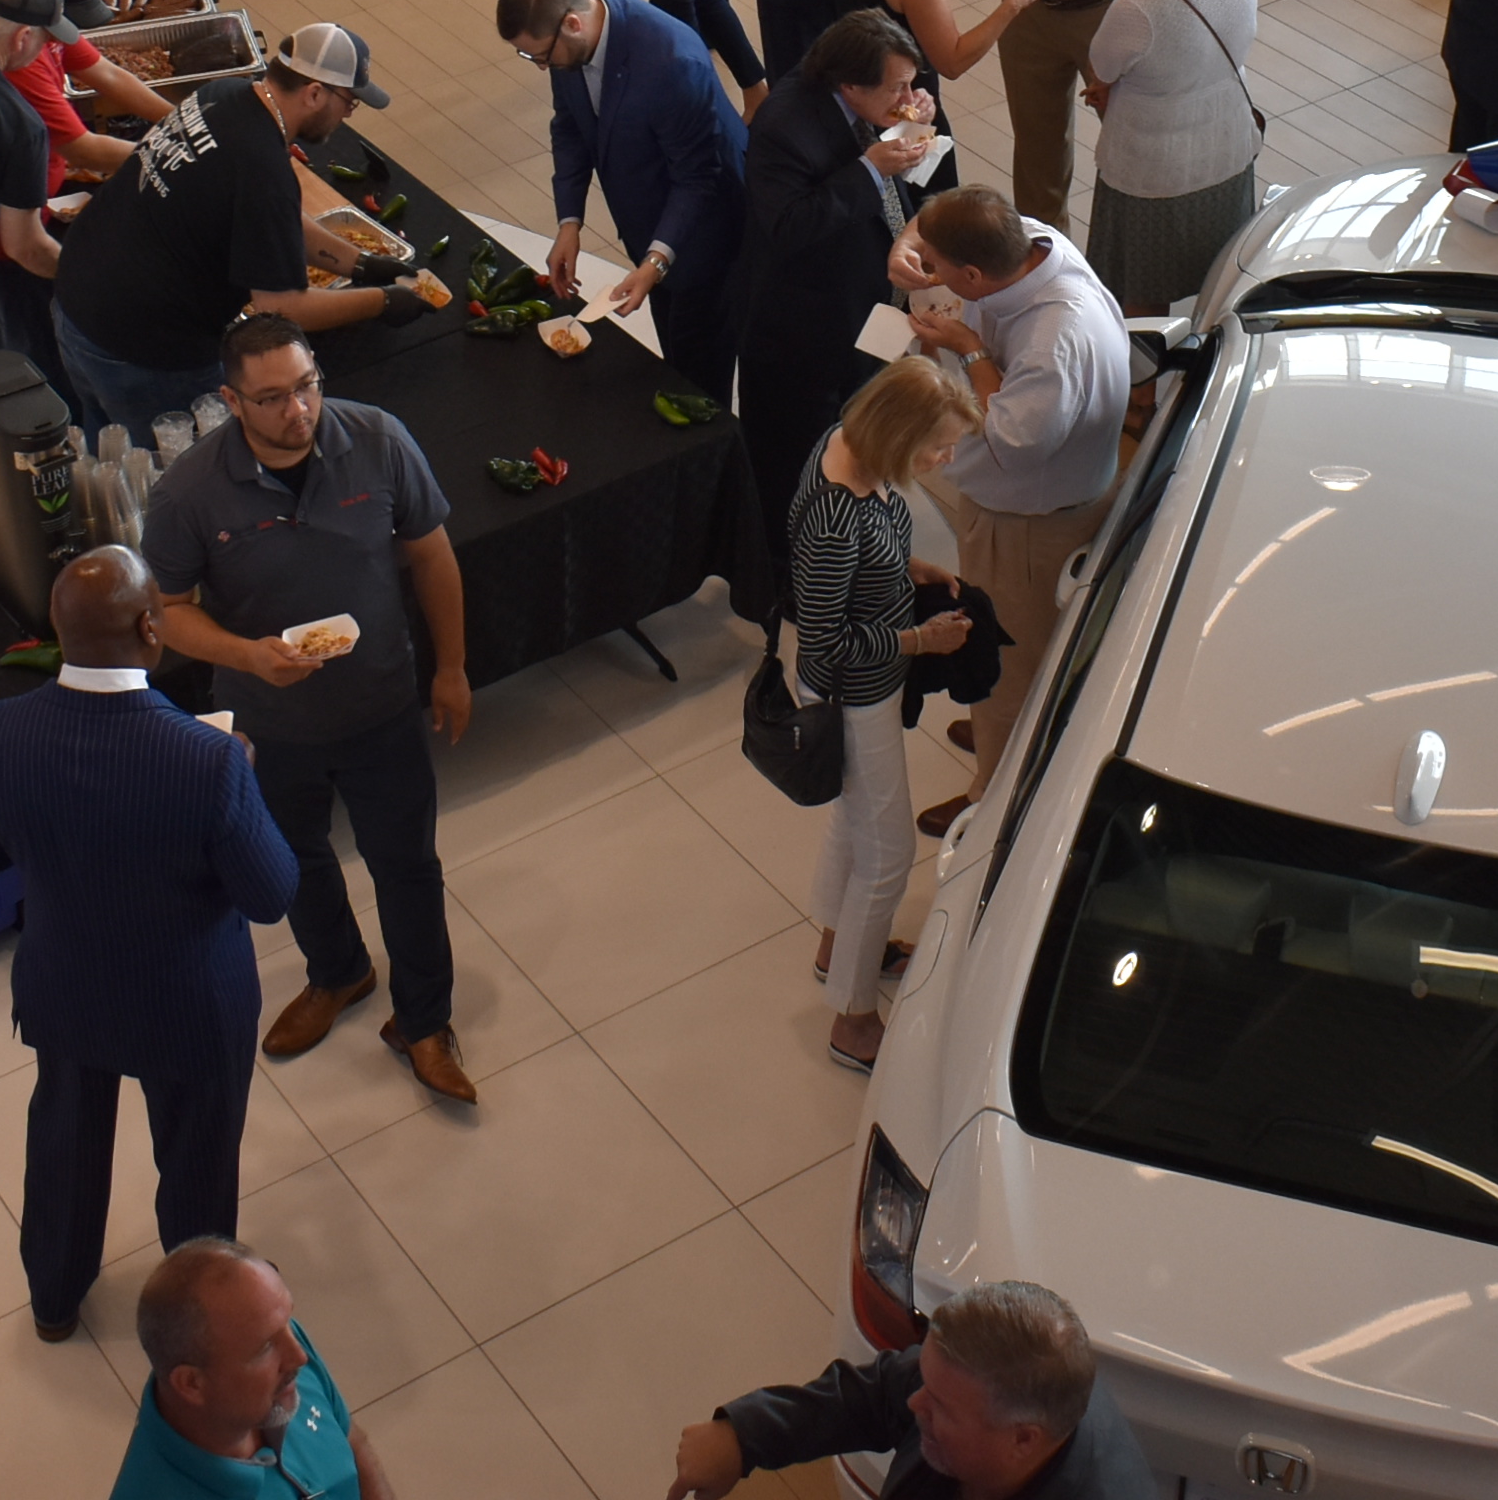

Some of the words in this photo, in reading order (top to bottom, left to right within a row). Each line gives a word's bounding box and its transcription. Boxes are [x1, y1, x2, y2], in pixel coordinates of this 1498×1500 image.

[193, 133, 219, 155] IT
[31, 465, 69, 487] PURE
[32, 477, 71, 497] LEAF
